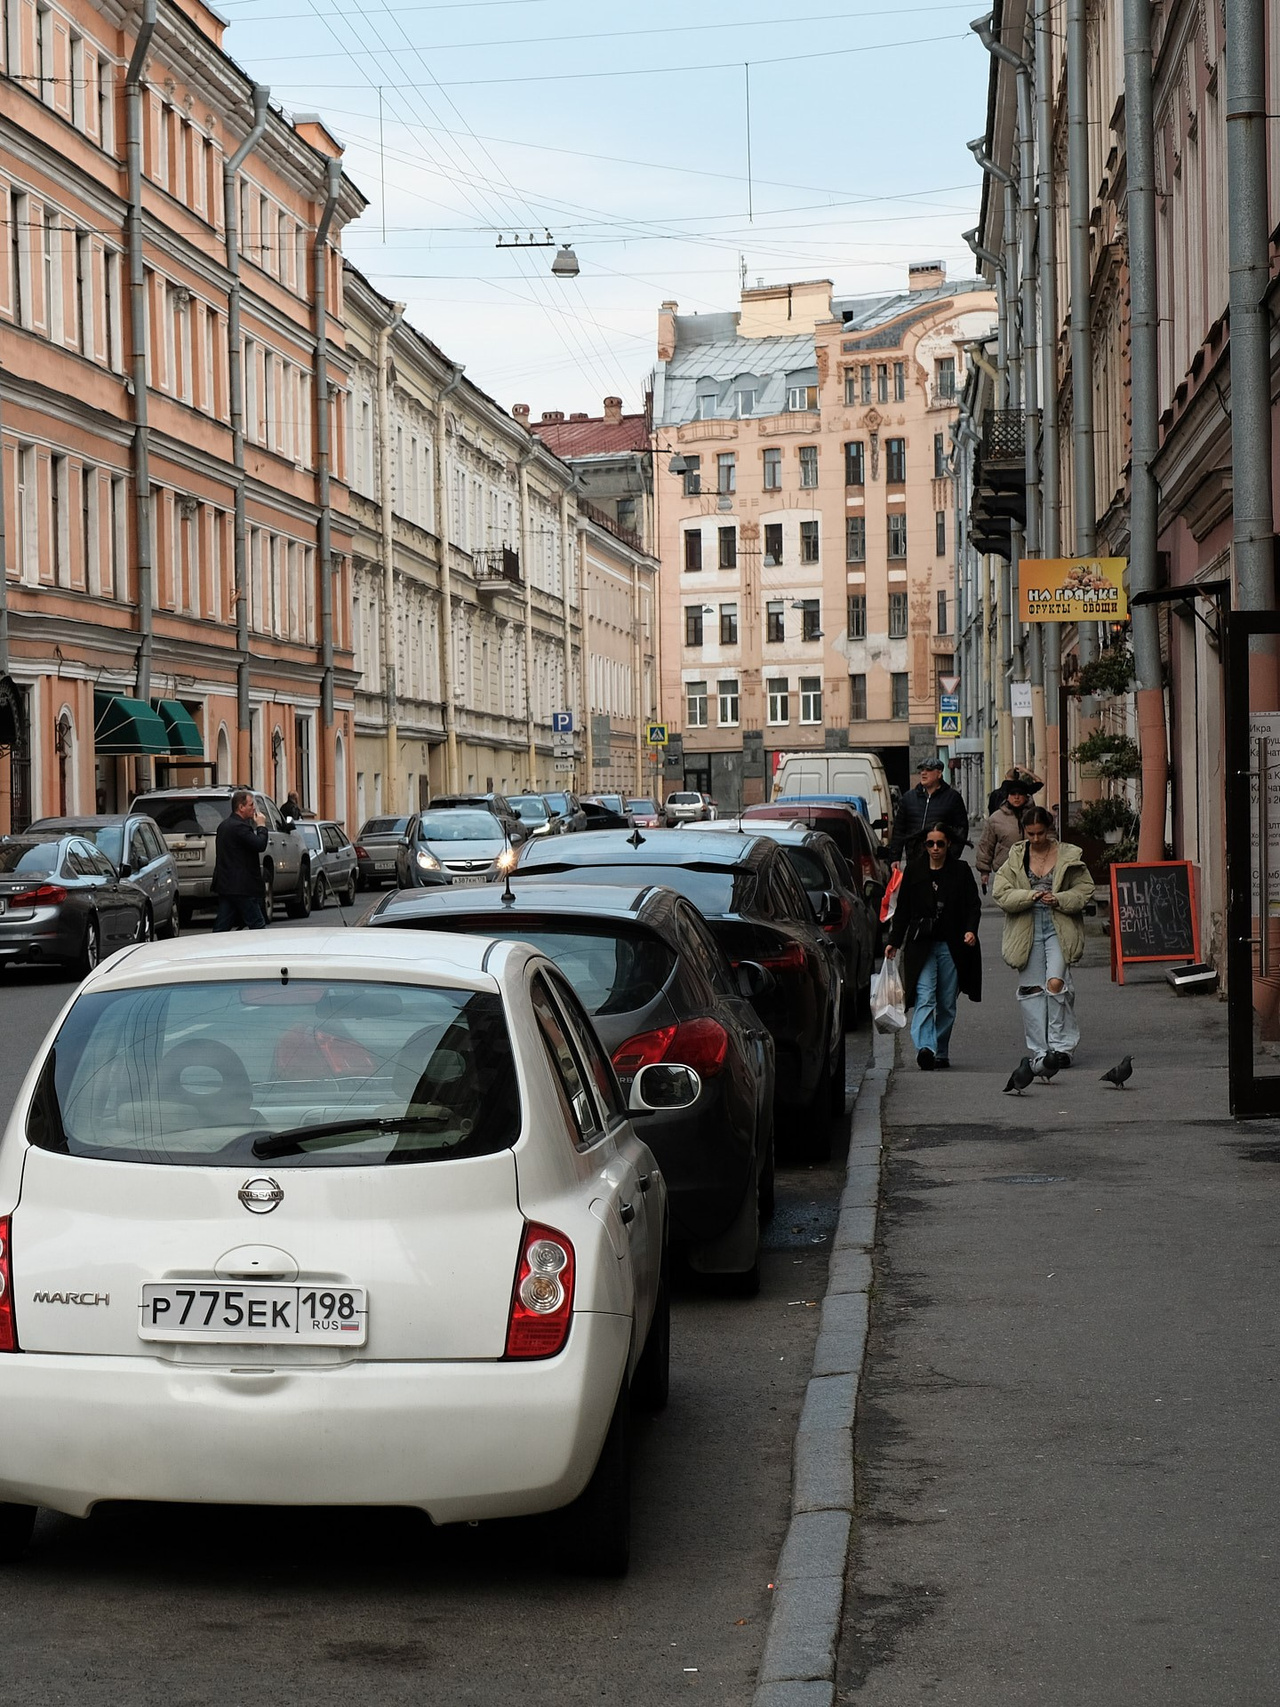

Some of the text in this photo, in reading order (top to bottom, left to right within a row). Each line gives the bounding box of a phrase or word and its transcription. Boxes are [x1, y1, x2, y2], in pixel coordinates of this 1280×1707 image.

[1028, 587, 1118, 602] НА ГРЯДКЕ
[1029, 603, 1118, 615] ФРУКТЫ ОВОЩИ
[1249, 724, 1271, 735] Икра
[1117, 881, 1150, 905] ТЫ
[242, 1190, 280, 1199] NISSAN
[33, 1290, 110, 1306] MARCH
[151, 1290, 355, 1328] Р775ЕК 198
[312, 1320, 339, 1331] RUS
